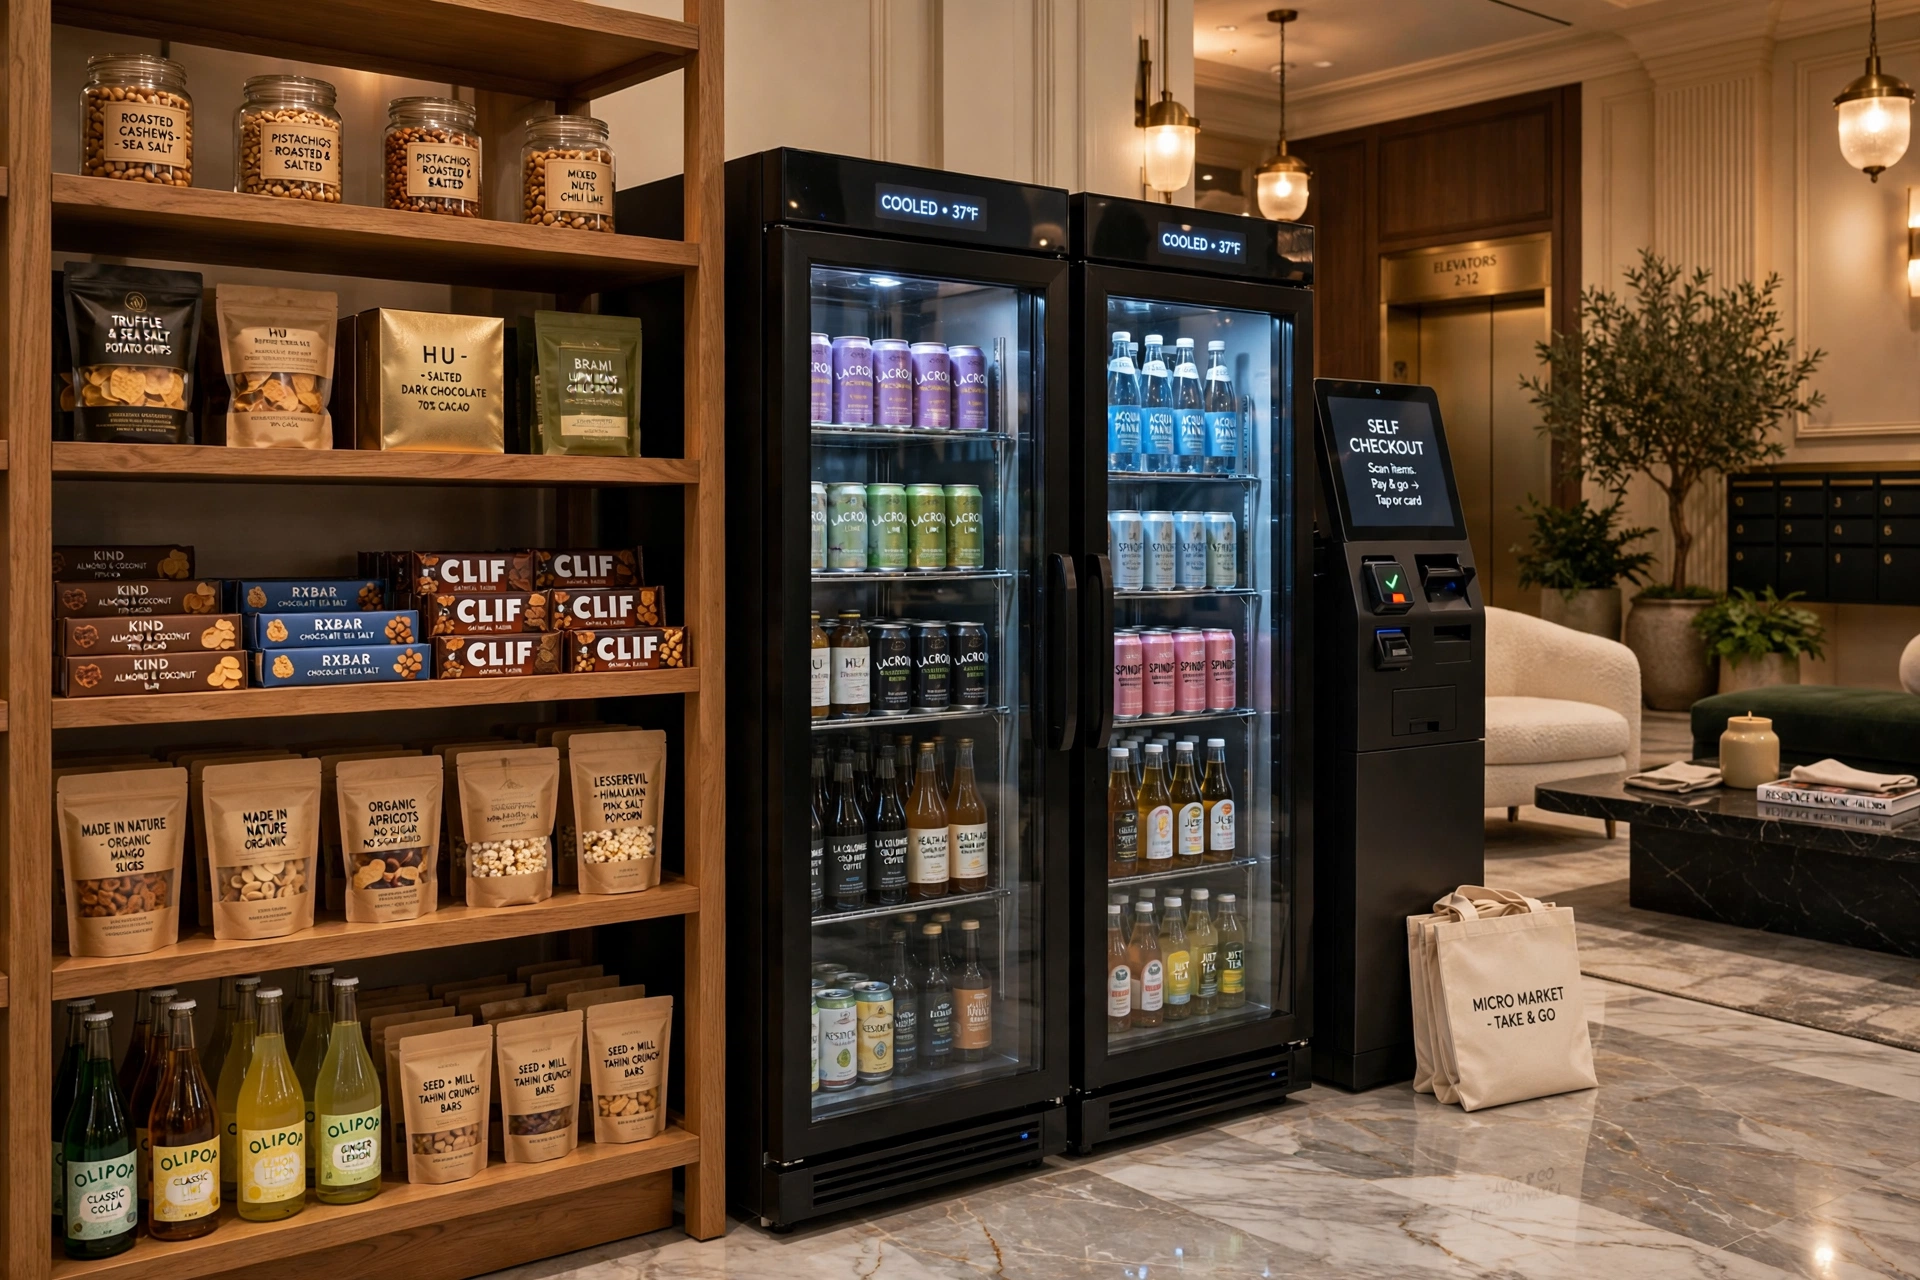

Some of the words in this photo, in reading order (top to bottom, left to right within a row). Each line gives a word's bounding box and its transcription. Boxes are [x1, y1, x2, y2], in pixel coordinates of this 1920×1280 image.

[121, 112, 174, 128] ROASTED
[119, 125, 174, 141] CASHEWS
[122, 139, 143, 151] SEA
[147, 142, 173, 154] SALT
[271, 133, 332, 149] PISTACHIOS
[275, 146, 322, 159] ROASTED
[324, 151, 331, 161] &
[416, 153, 471, 167] PISTACHIOS
[284, 159, 322, 172] SALTED
[571, 180, 596, 192] NUTS
[882, 195, 938, 216] COOLED
[952, 205, 979, 221] 37°F
[1162, 233, 1208, 251] COOLED
[1434, 254, 1497, 274] ELEVATORS
[1454, 271, 1479, 286] 2-12
[111, 314, 163, 329] TRUFFLE
[107, 328, 116, 339] &
[120, 328, 141, 341] SEA
[143, 329, 171, 342] SALT
[269, 327, 287, 338] HU
[105, 342, 142, 354] POTATO
[422, 345, 455, 365] HU
[574, 358, 612, 371] BRAMI
[428, 371, 462, 383] SALTED
[401, 384, 428, 396] DARK
[430, 386, 487, 398] CHOCOLATE
[418, 401, 436, 411] 70%
[438, 401, 470, 412] CACAO
[1367, 418, 1399, 435] SELF
[1350, 437, 1424, 455] CHECKOUT
[1367, 462, 1390, 474] Scan
[1370, 478, 1387, 492] Pay
[1388, 478, 1396, 489] &
[1397, 481, 1408, 492] go
[1375, 494, 1392, 508] Tap
[1392, 496, 1402, 506] or
[1403, 495, 1422, 506] card
[1784, 496, 1792, 507] 2
[94, 551, 124, 561] KIND
[441, 559, 505, 583] CLIF
[553, 554, 613, 578] CLIF
[117, 585, 149, 596] KIND
[292, 586, 337, 598] RXBAR
[456, 598, 522, 624] CLIF
[572, 595, 634, 619] CLIF
[129, 620, 163, 632] KIND
[314, 618, 363, 631] RXBAR
[466, 641, 532, 667] CLIF
[597, 636, 658, 661] CLIF
[134, 659, 168, 670] KIND
[322, 653, 371, 666] RXBAR
[594, 773, 648, 787] LESSEREVIL
[600, 788, 645, 799] HIMALAYAN
[368, 798, 416, 812] ORGANIC
[625, 799, 644, 809] SALT
[243, 810, 274, 824] MADE
[276, 808, 288, 820] IN
[369, 811, 419, 826] APRICOTS
[605, 811, 642, 823] POPCORN
[82, 822, 111, 837] MADE
[113, 821, 125, 834] IN
[127, 817, 166, 832] NATURE
[247, 822, 288, 836] NATURE
[374, 827, 388, 837] NO
[107, 834, 151, 848] ORGANIC
[244, 836, 287, 850] ORGANIC
[875, 840, 883, 848] LA
[110, 848, 145, 861] MANGO
[833, 845, 841, 853] LA
[115, 860, 145, 872] SLICES
[1472, 993, 1514, 1012] MICRO
[1517, 986, 1564, 1006] MARKET
[1494, 1012, 1525, 1029] TAKE
[1527, 1011, 1536, 1024] &
[1538, 1008, 1556, 1022] GO
[608, 1045, 628, 1056] SEED
[637, 1040, 656, 1051] MILL
[519, 1063, 539, 1074] SEED
[549, 1057, 567, 1069] MILL
[604, 1057, 630, 1069] TAHINI
[632, 1051, 660, 1065] CRUNCH
[514, 1075, 541, 1087] TAHINI
[542, 1069, 572, 1083] CRUNCH
[624, 1066, 644, 1078] BARS
[423, 1080, 445, 1092] SEED
[455, 1074, 475, 1086] MILL
[535, 1084, 555, 1096] BARS
[419, 1091, 446, 1104] TAHINI
[448, 1085, 480, 1099] CRUNCH
[440, 1102, 462, 1114] BARS
[328, 1117, 379, 1138] OLIPOP
[250, 1132, 302, 1153] OLIPOP
[161, 1149, 217, 1171] OLIPOP
[75, 1164, 134, 1187] OLIPOP
[87, 1188, 124, 1204] CLASSIC
